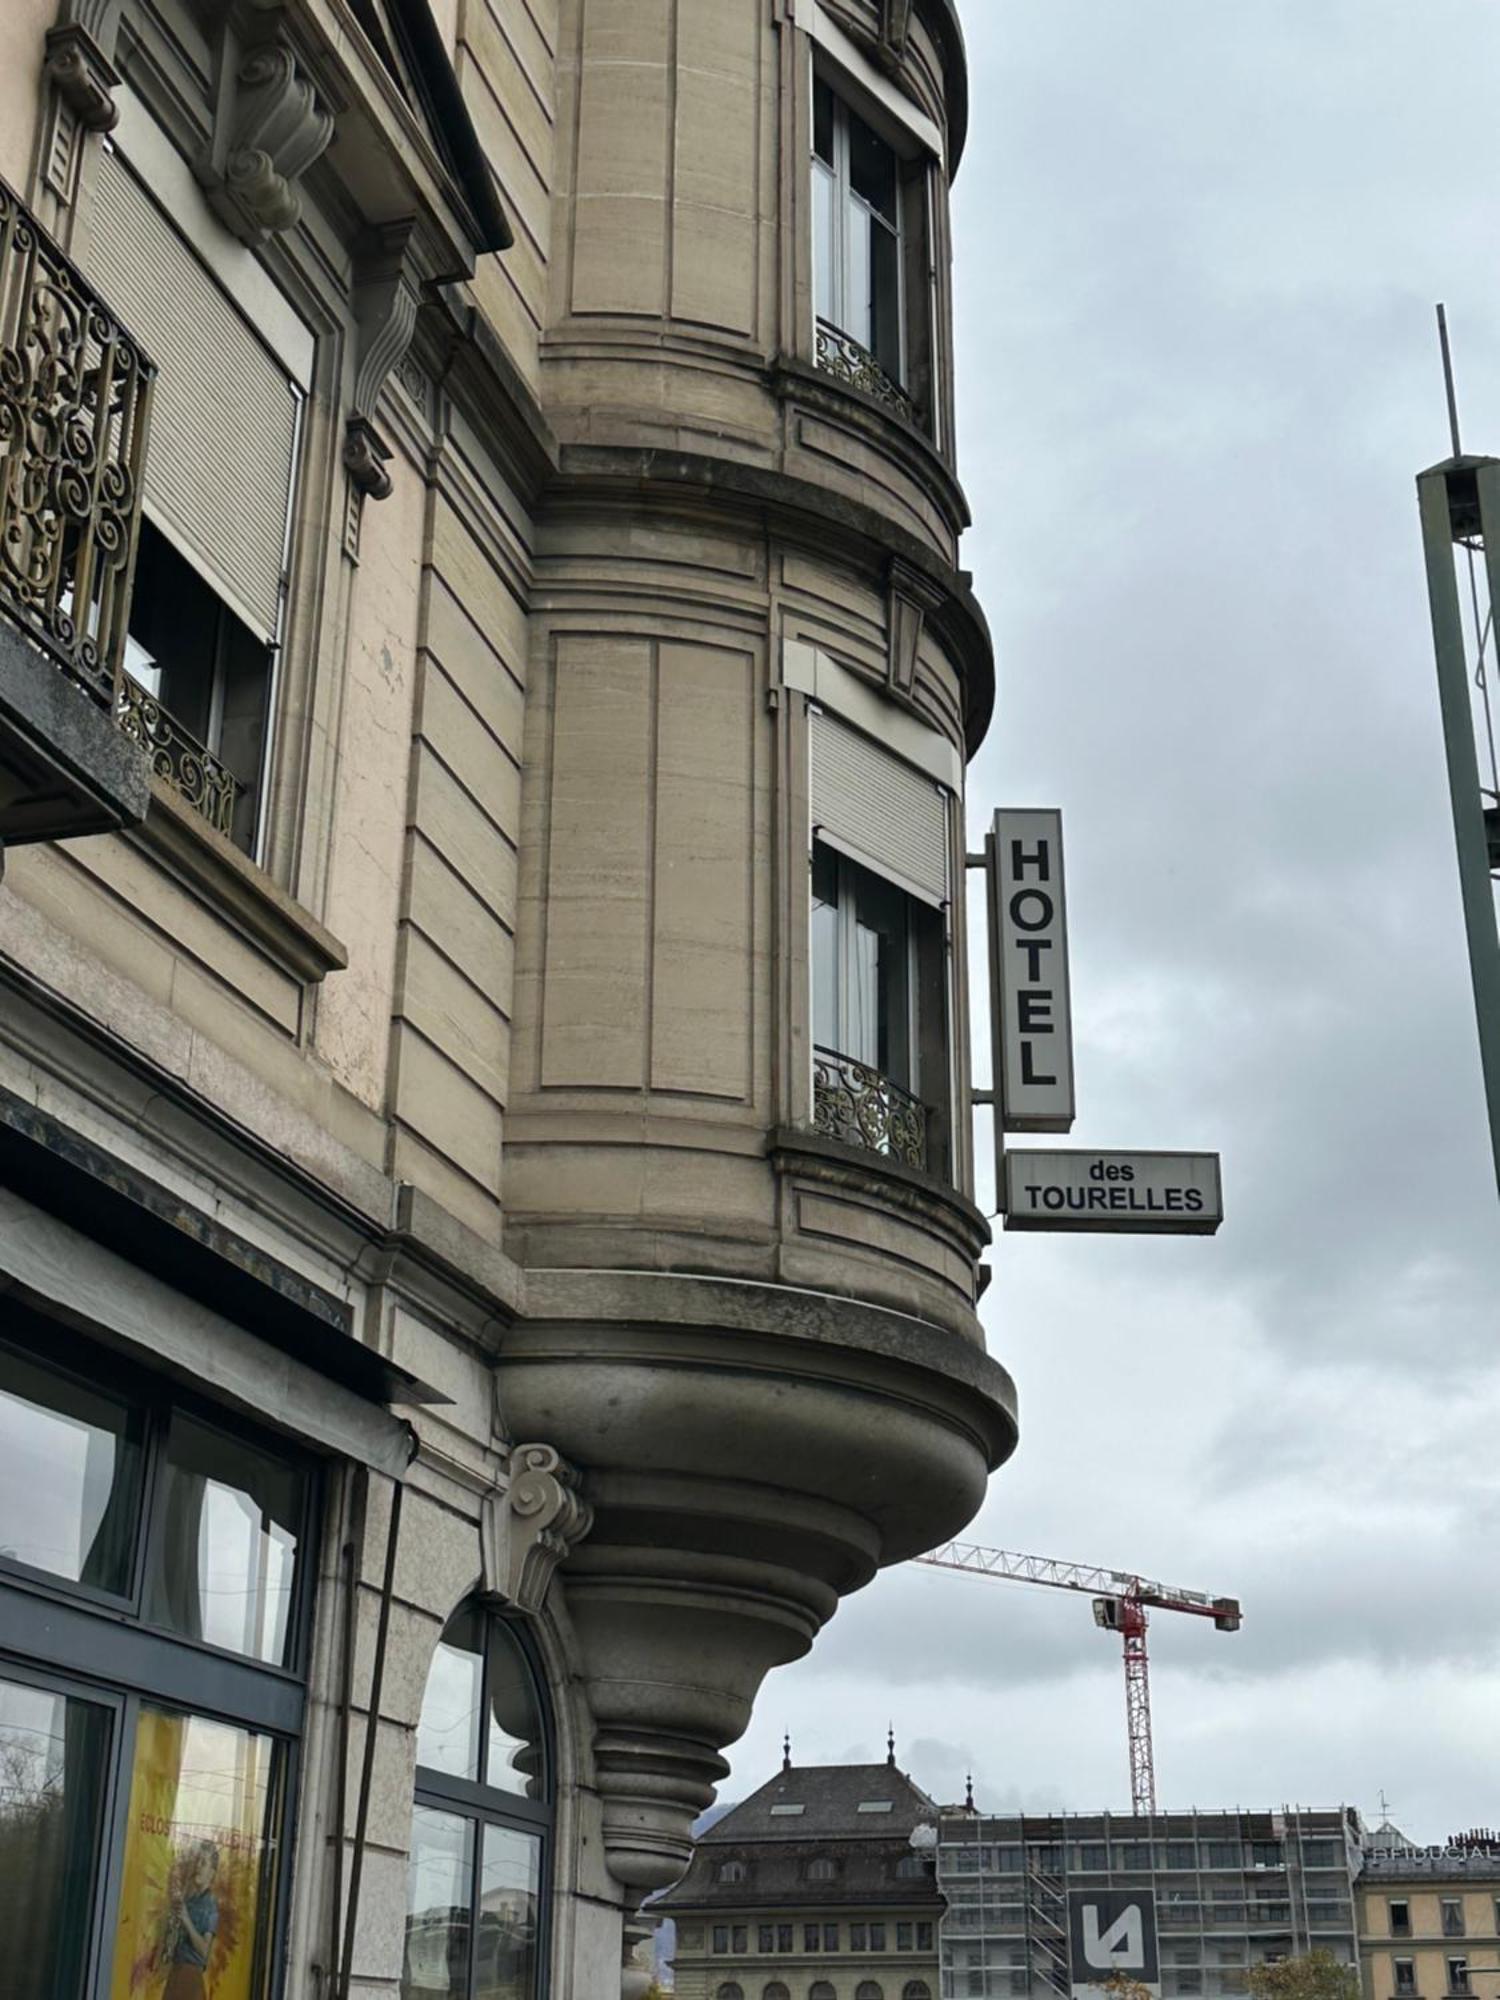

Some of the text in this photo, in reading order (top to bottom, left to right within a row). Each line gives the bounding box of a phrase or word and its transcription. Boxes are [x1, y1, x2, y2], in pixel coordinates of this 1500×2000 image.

[1009, 839, 1057, 1086] HOTEL
[1089, 1159, 1135, 1182] des
[1025, 1185, 1204, 1212] TOURELLES
